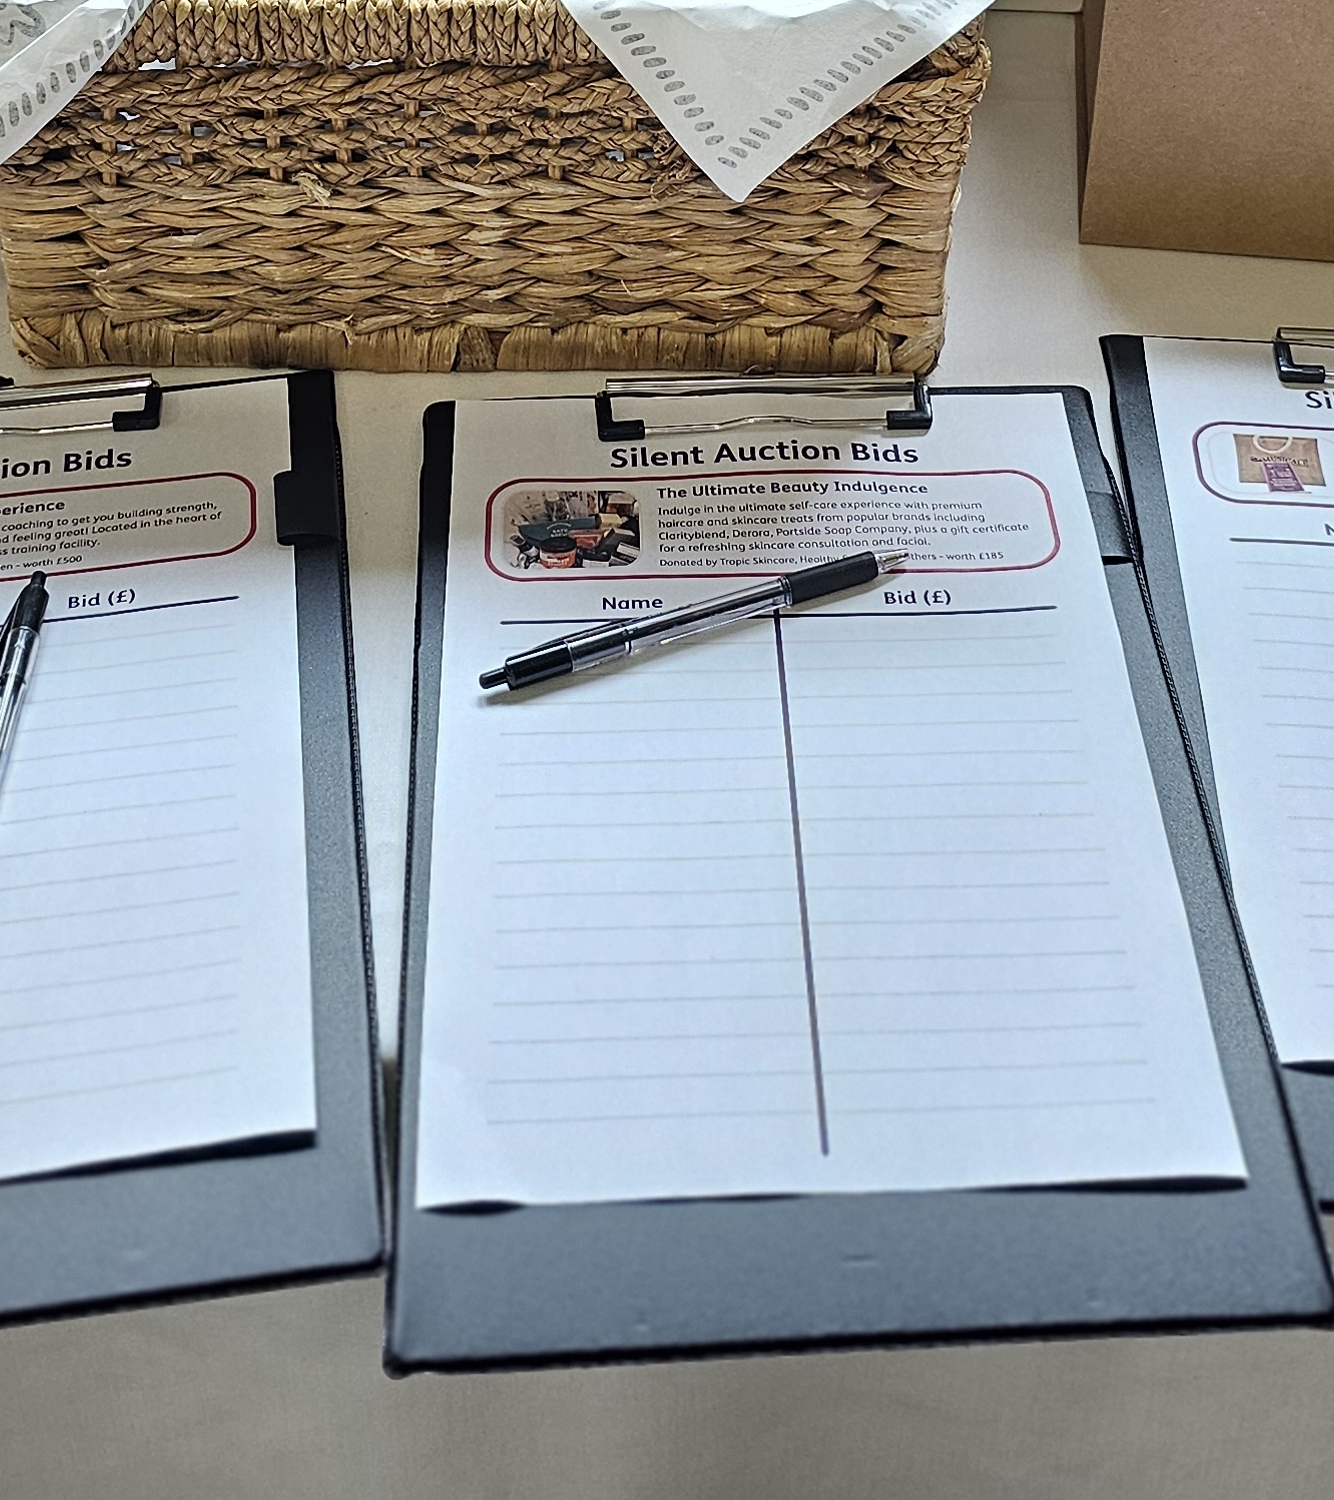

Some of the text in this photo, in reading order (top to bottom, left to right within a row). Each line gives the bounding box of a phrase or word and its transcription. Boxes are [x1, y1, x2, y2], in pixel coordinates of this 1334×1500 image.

[64, 449, 132, 472] Bids
[611, 442, 918, 468] Silent Auction Bids
[657, 481, 928, 499] The Ultimate Beauty Indulgence
[660, 544, 675, 552] for
[689, 542, 745, 552] refreshing
[749, 541, 794, 550] skincare
[798, 539, 868, 548] consultation
[872, 537, 894, 546] and
[897, 537, 931, 545] facial.
[69, 593, 100, 609] Bid
[108, 589, 135, 606] (£)
[603, 590, 951, 610] Name Bid (£)
